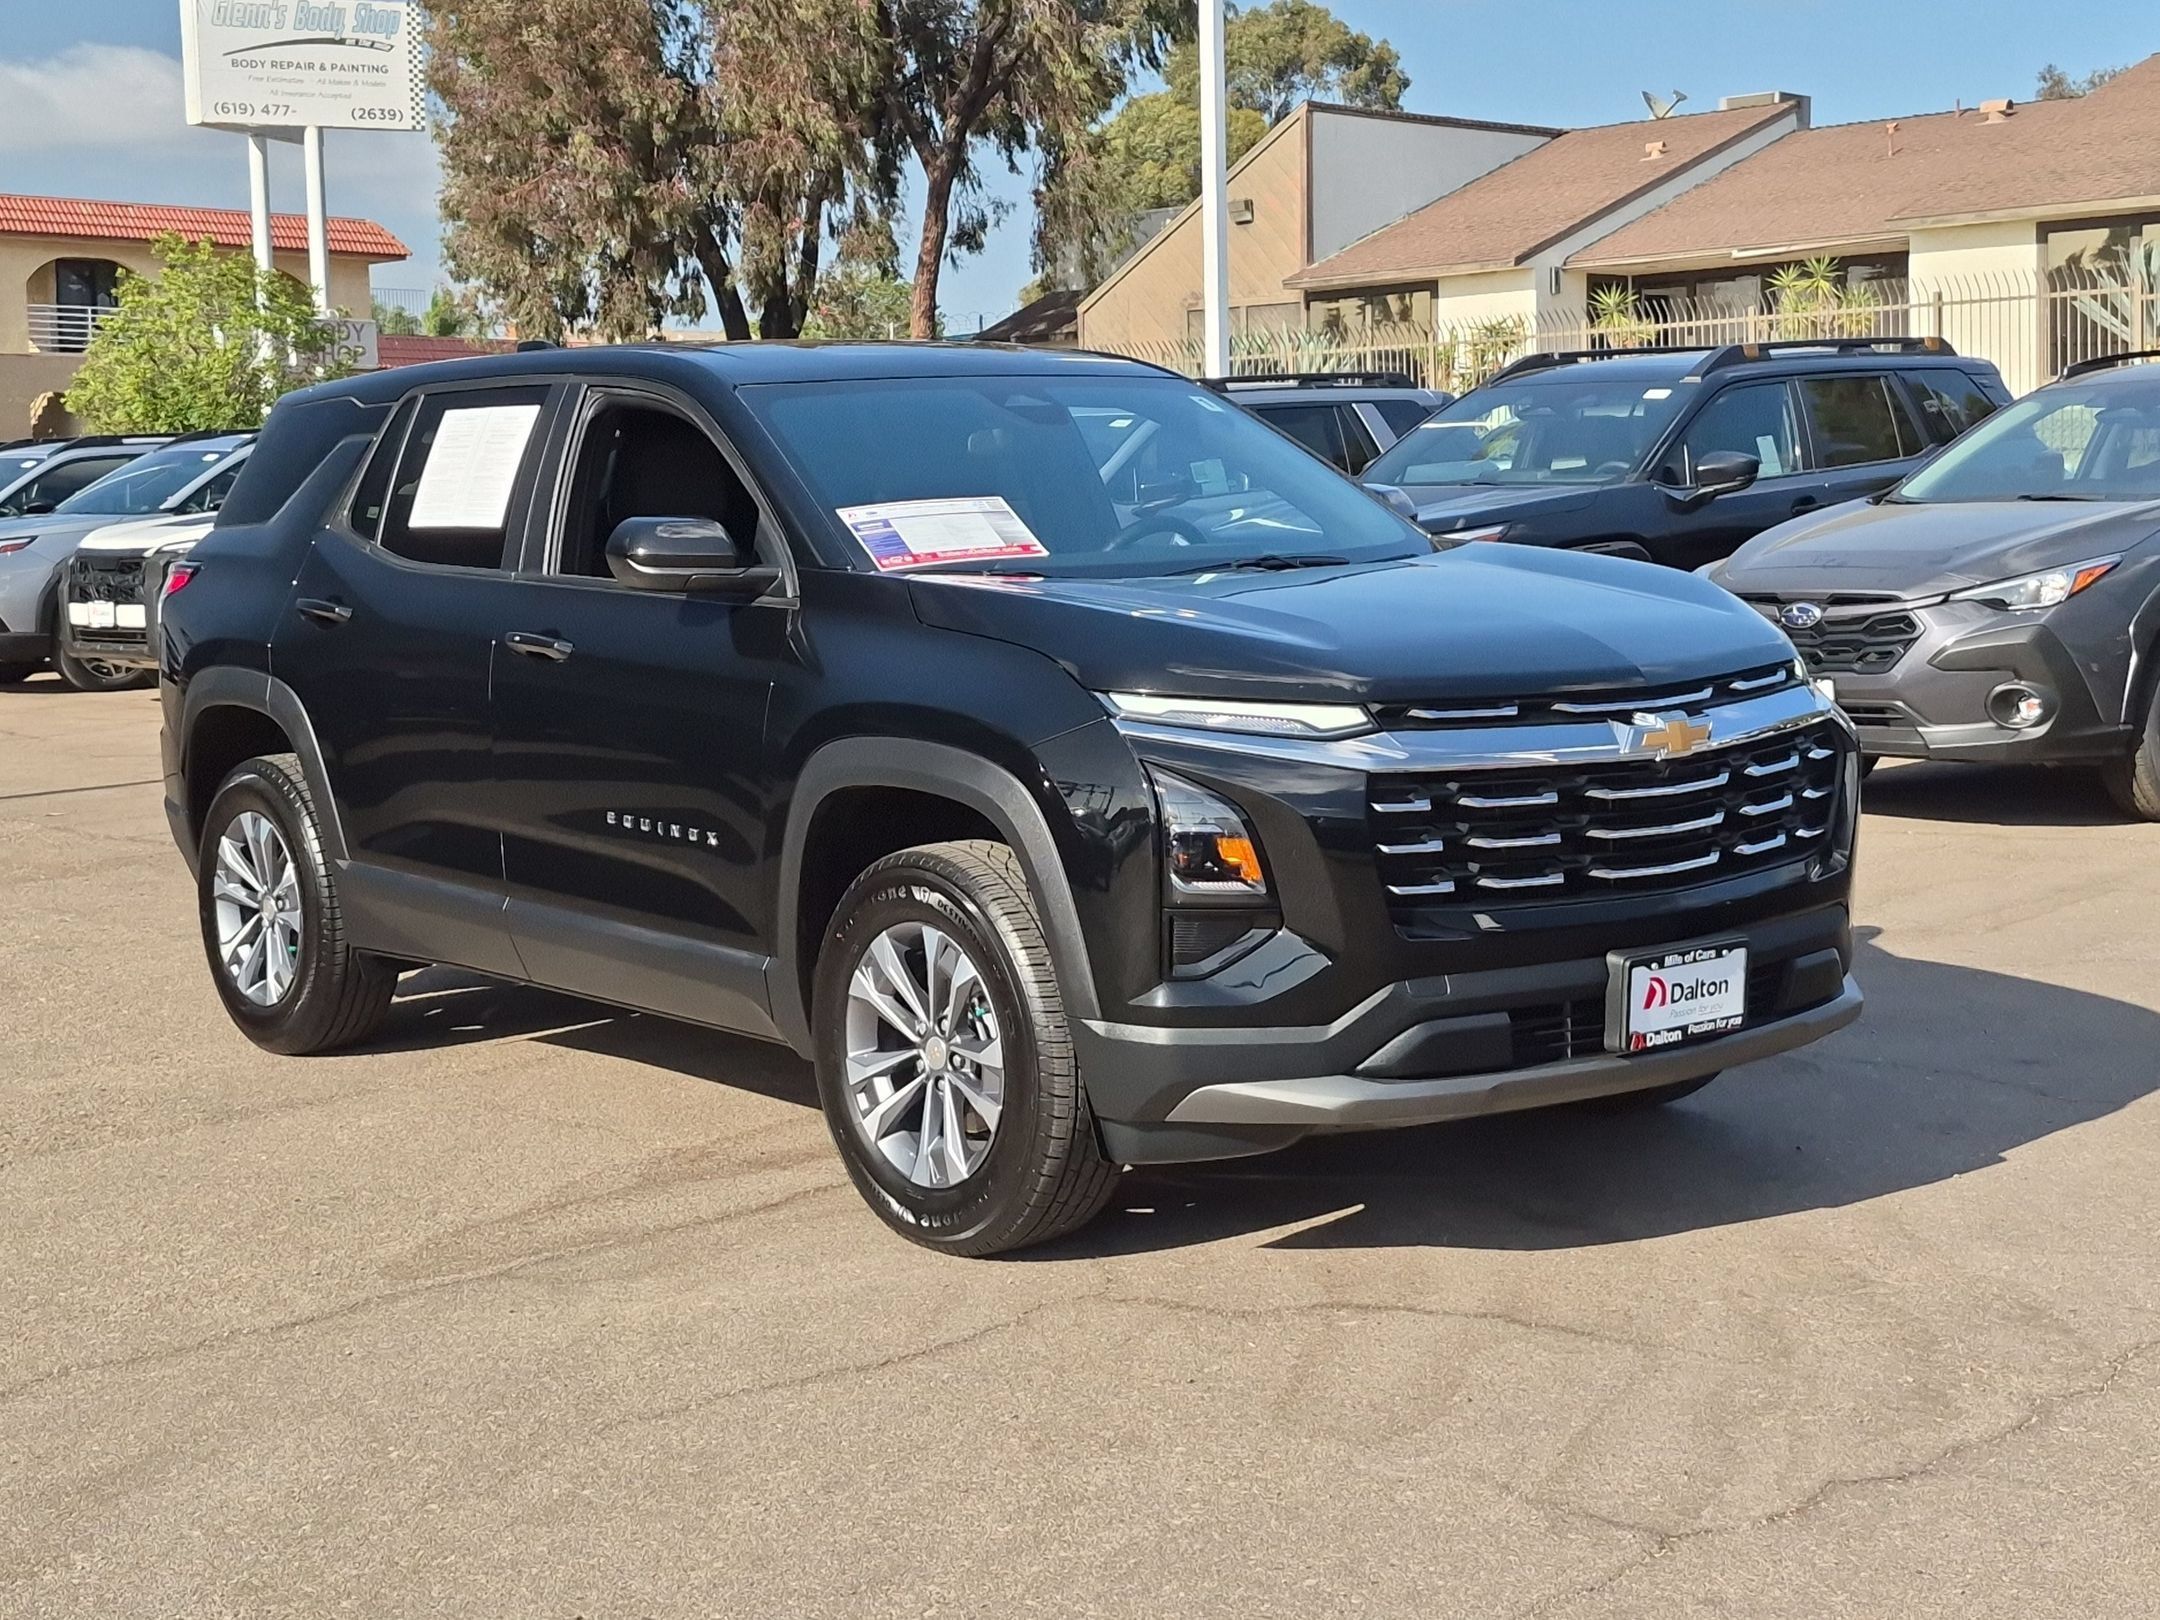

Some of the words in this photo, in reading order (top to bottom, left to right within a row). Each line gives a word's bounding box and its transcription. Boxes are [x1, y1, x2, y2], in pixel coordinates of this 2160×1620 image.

[293, 0, 346, 40] Body
[352, 3, 401, 40] Shop
[231, 58, 266, 69] BODY
[271, 60, 315, 72] REPAIR
[319, 62, 327, 72] &
[331, 63, 389, 74] PAINTING
[214, 102, 255, 117] (619)
[351, 107, 404, 122] (2639)
[606, 811, 719, 846] EQUINOX
[1684, 950, 1696, 962] of
[1696, 949, 1717, 961] Cars
[1670, 977, 1729, 1005] Dalton
[1646, 1029, 1682, 1047] Dalton
[1688, 1020, 1715, 1035] Passion
[1715, 1018, 1728, 1031] for
[1727, 1016, 1743, 1030] you
